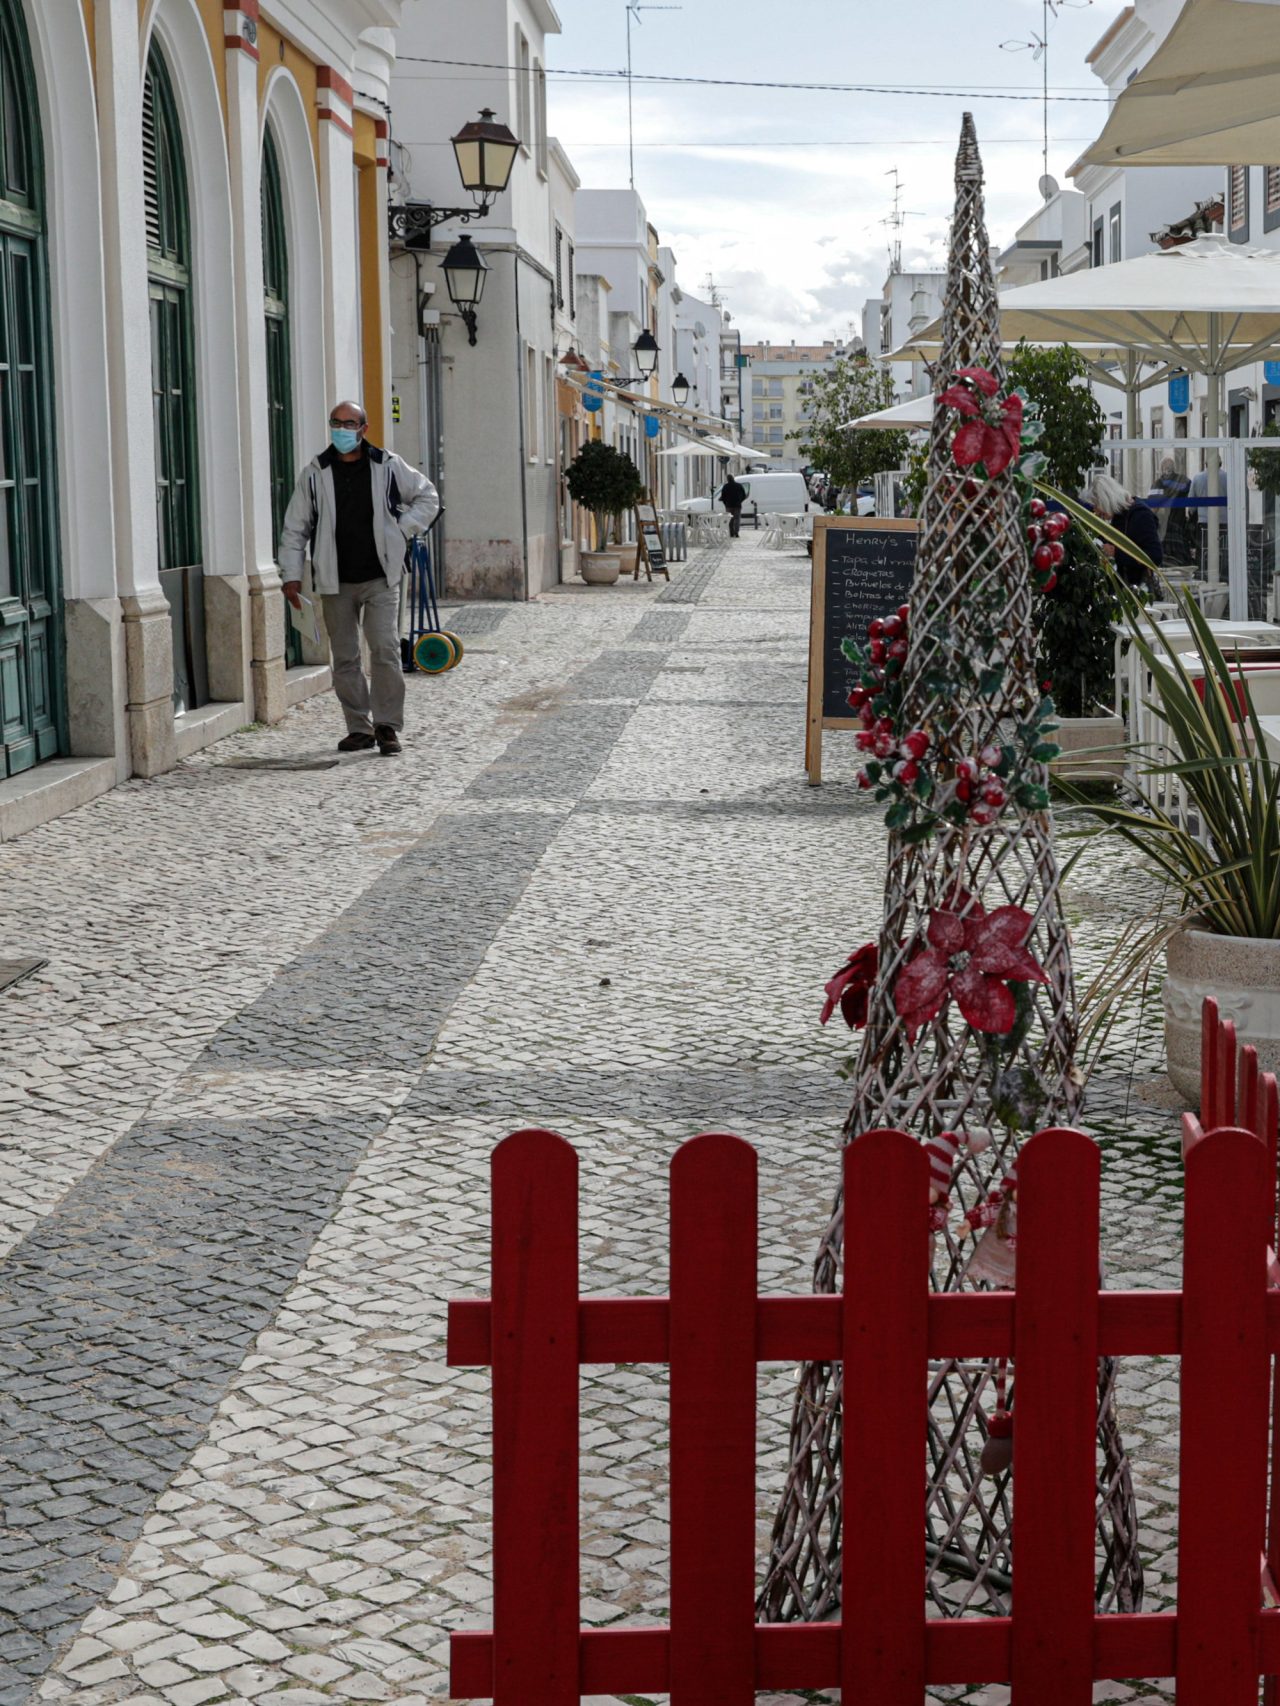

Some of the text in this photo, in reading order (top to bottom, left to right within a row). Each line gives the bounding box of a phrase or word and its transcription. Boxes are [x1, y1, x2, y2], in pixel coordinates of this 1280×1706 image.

[842, 568, 895, 580] Croquetas
[845, 578, 892, 590] Buñuelos
[844, 590, 882, 599] Bolitas
